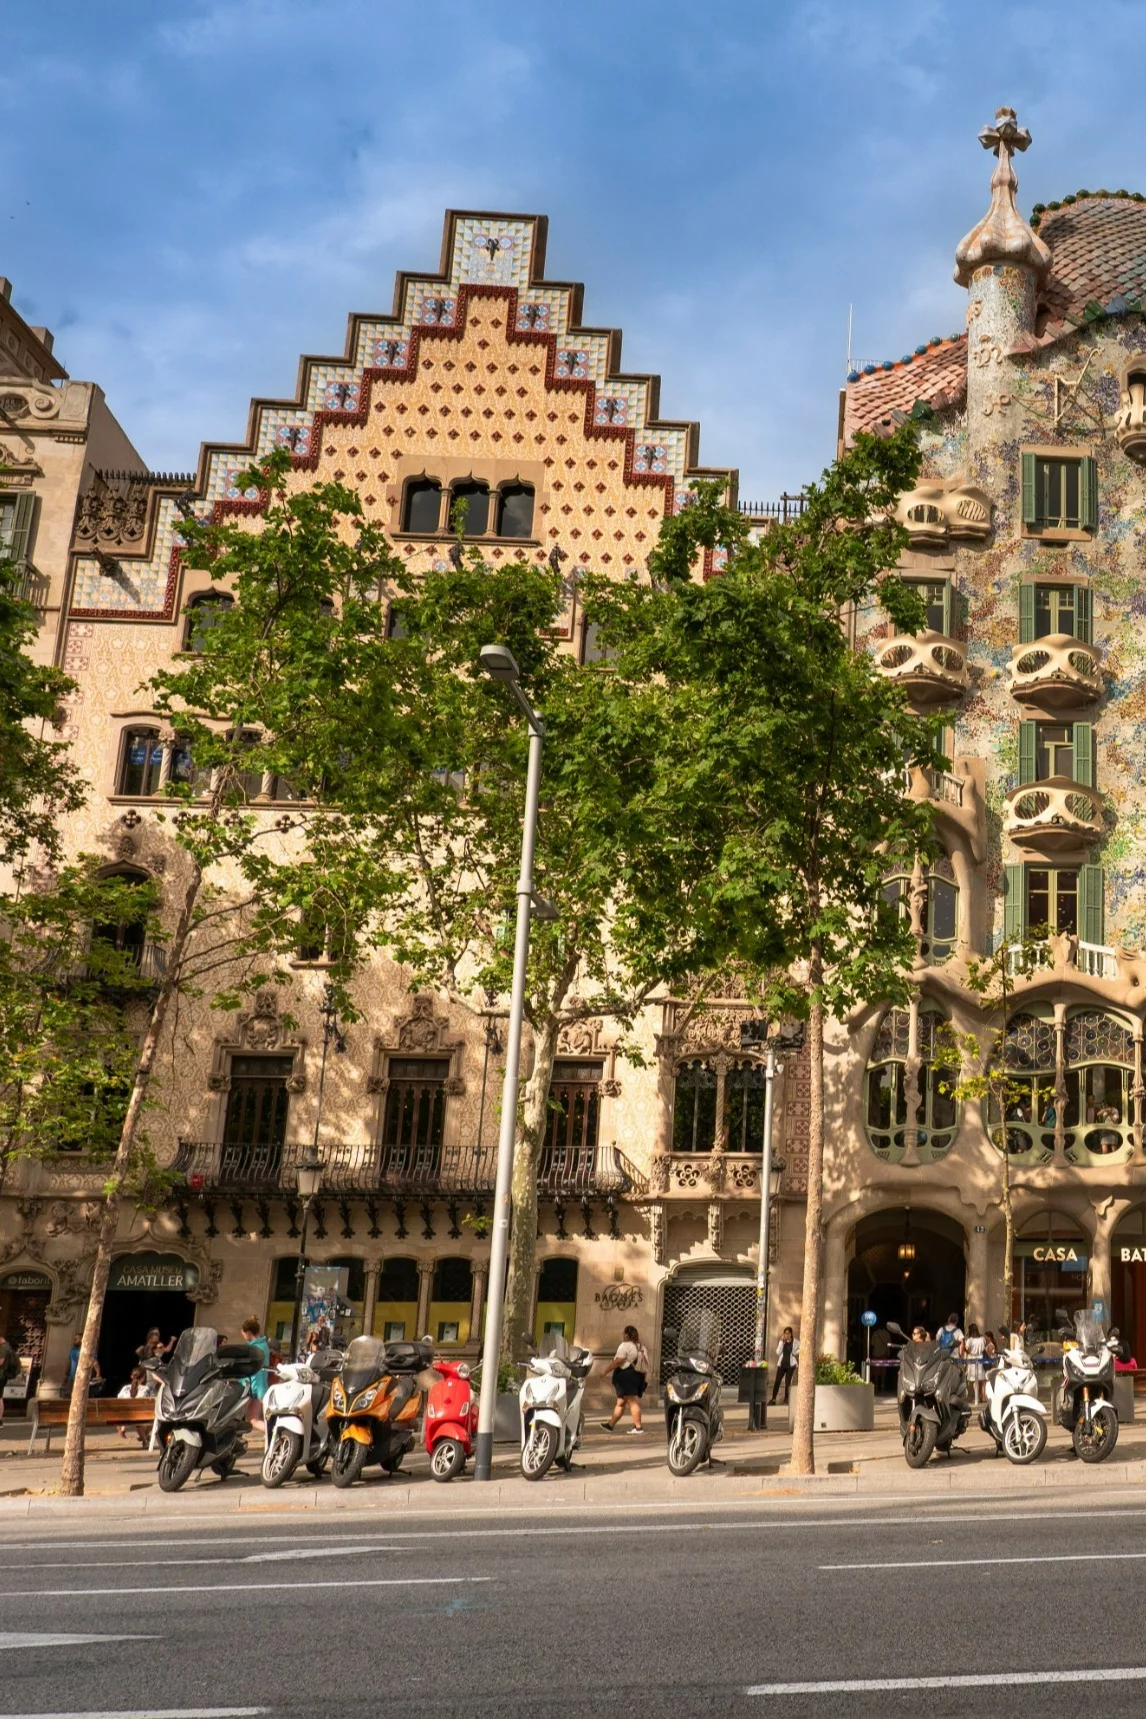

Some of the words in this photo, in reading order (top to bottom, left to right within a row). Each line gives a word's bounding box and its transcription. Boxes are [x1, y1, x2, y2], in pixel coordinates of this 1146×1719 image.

[1033, 1247, 1078, 1262] CASA
[123, 1264, 149, 1274] CASA
[116, 1274, 184, 1287] AMATLLER
